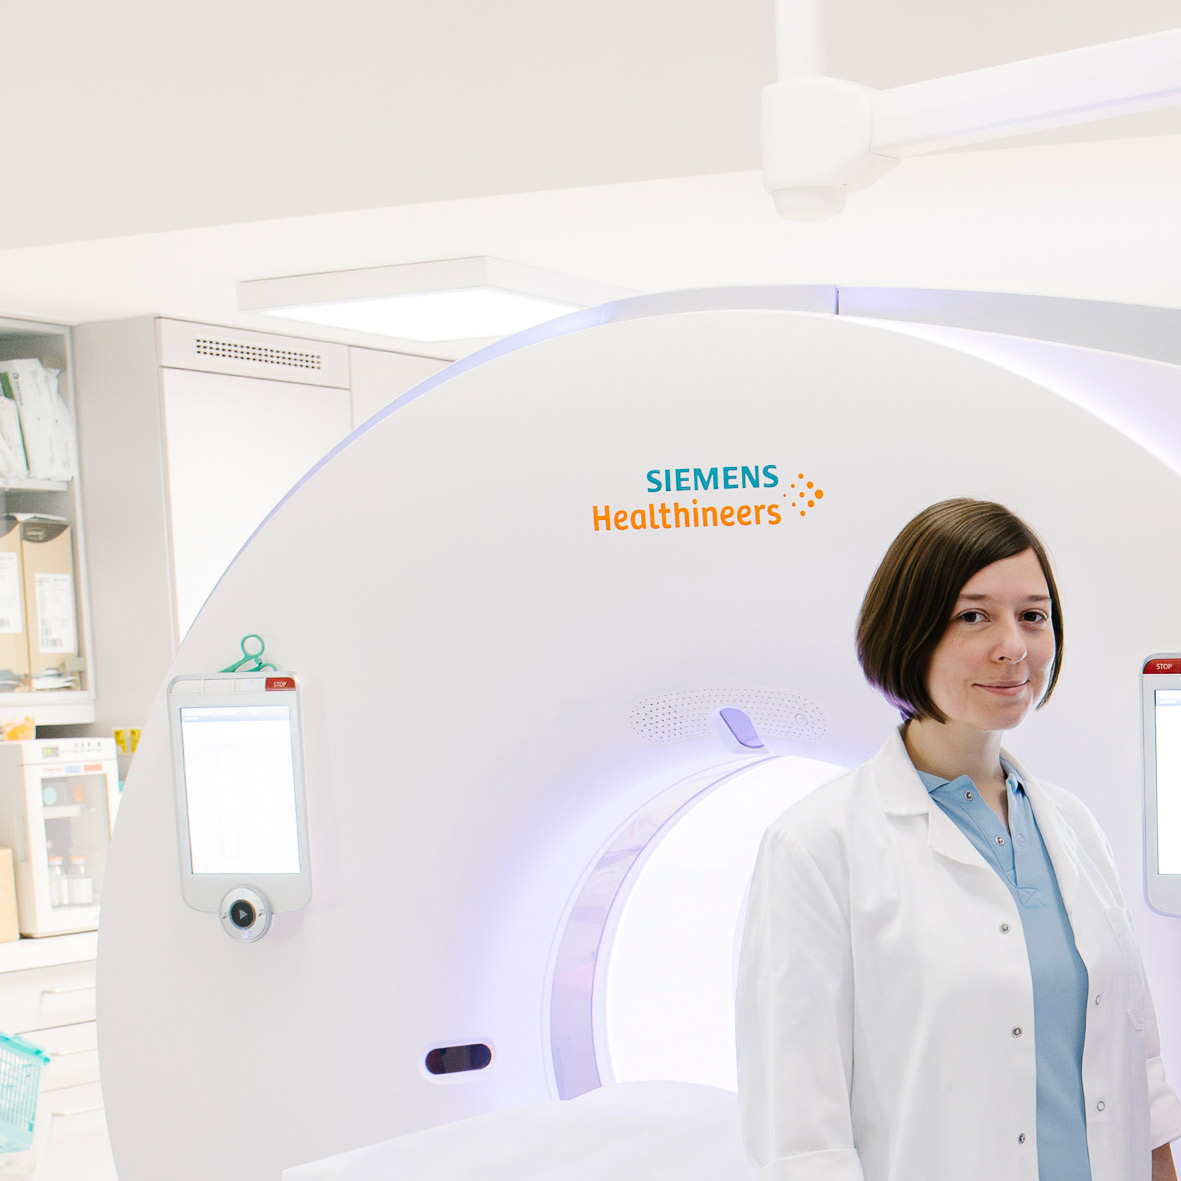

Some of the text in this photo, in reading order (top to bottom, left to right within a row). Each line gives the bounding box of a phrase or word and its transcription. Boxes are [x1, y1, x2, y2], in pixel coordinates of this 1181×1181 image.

[646, 464, 779, 493] SIEMENS
[592, 498, 782, 532] Healthineers
[1156, 663, 1173, 671] STOP
